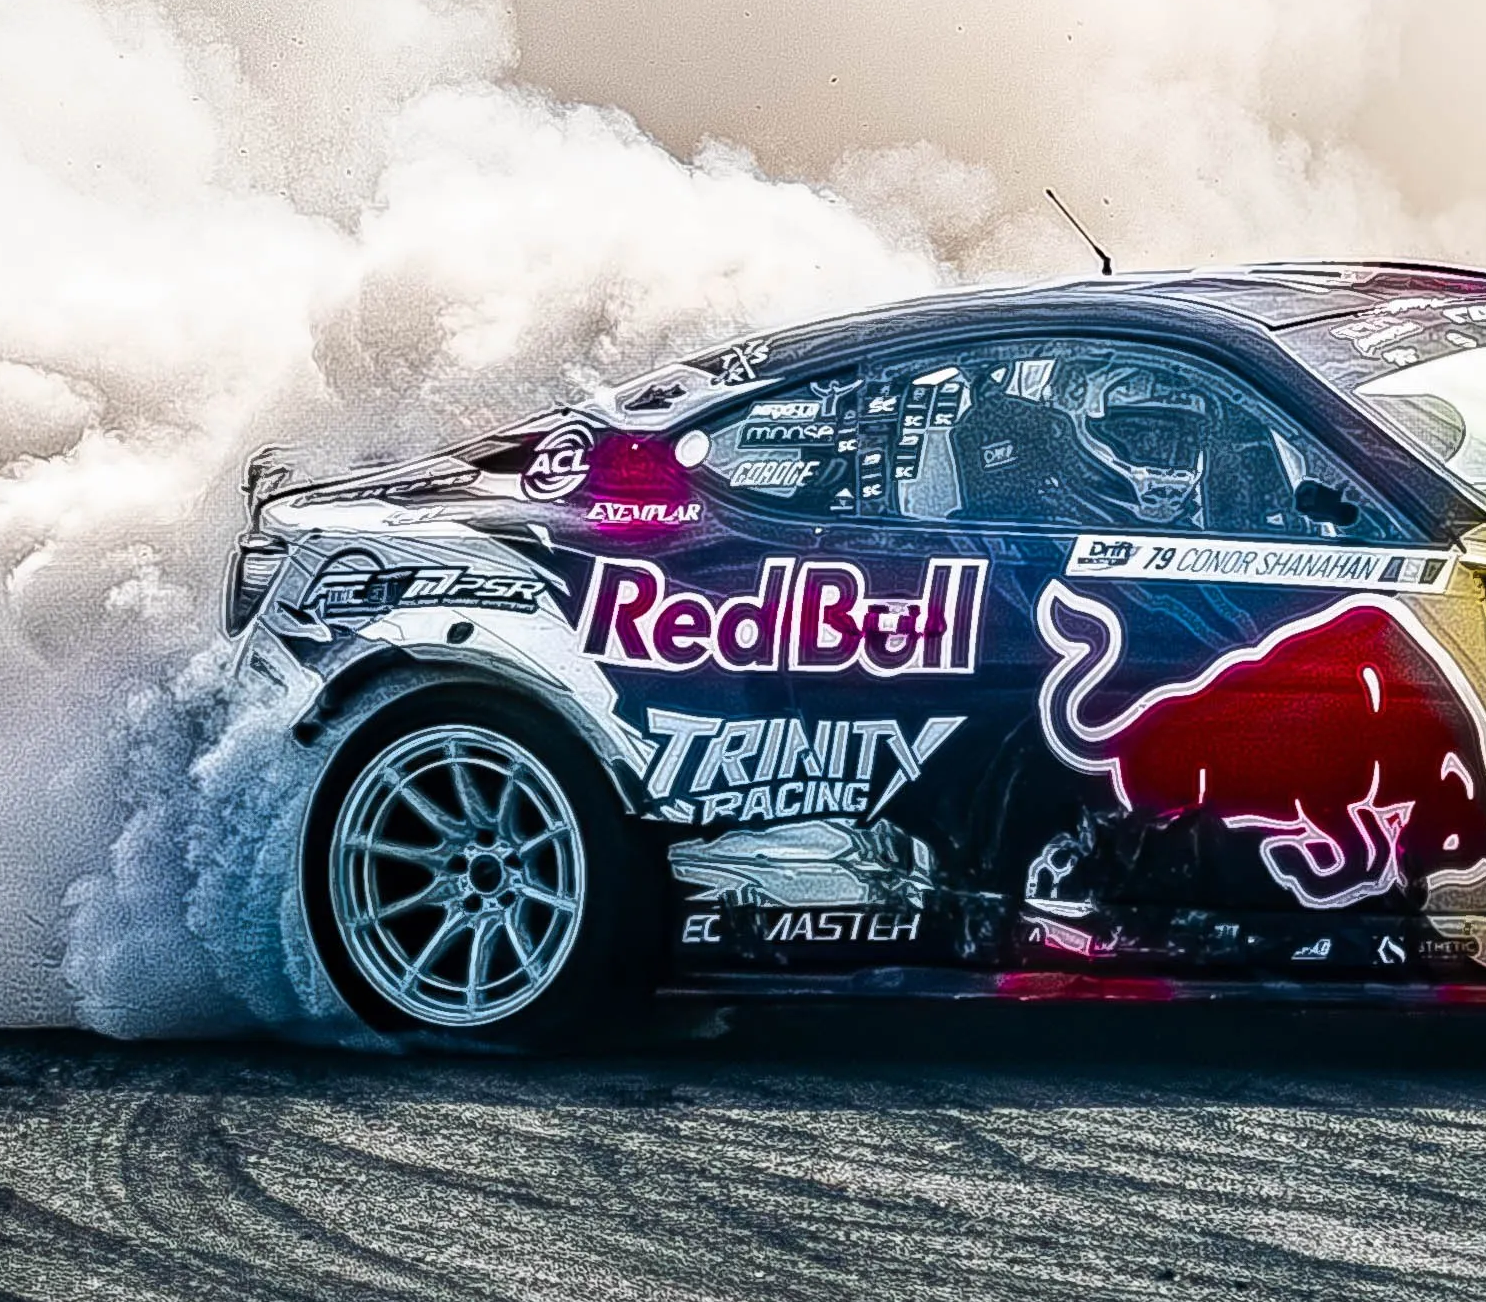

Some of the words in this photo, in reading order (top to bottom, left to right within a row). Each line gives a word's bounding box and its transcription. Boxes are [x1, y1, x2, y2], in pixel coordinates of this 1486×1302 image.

[524, 449, 591, 477] ACL
[1143, 546, 1176, 570] 79
[1176, 547, 1258, 576] CONOR
[1255, 552, 1382, 581] SHANAHAN
[646, 707, 968, 821] TRINITY
[702, 780, 871, 825] RACING
